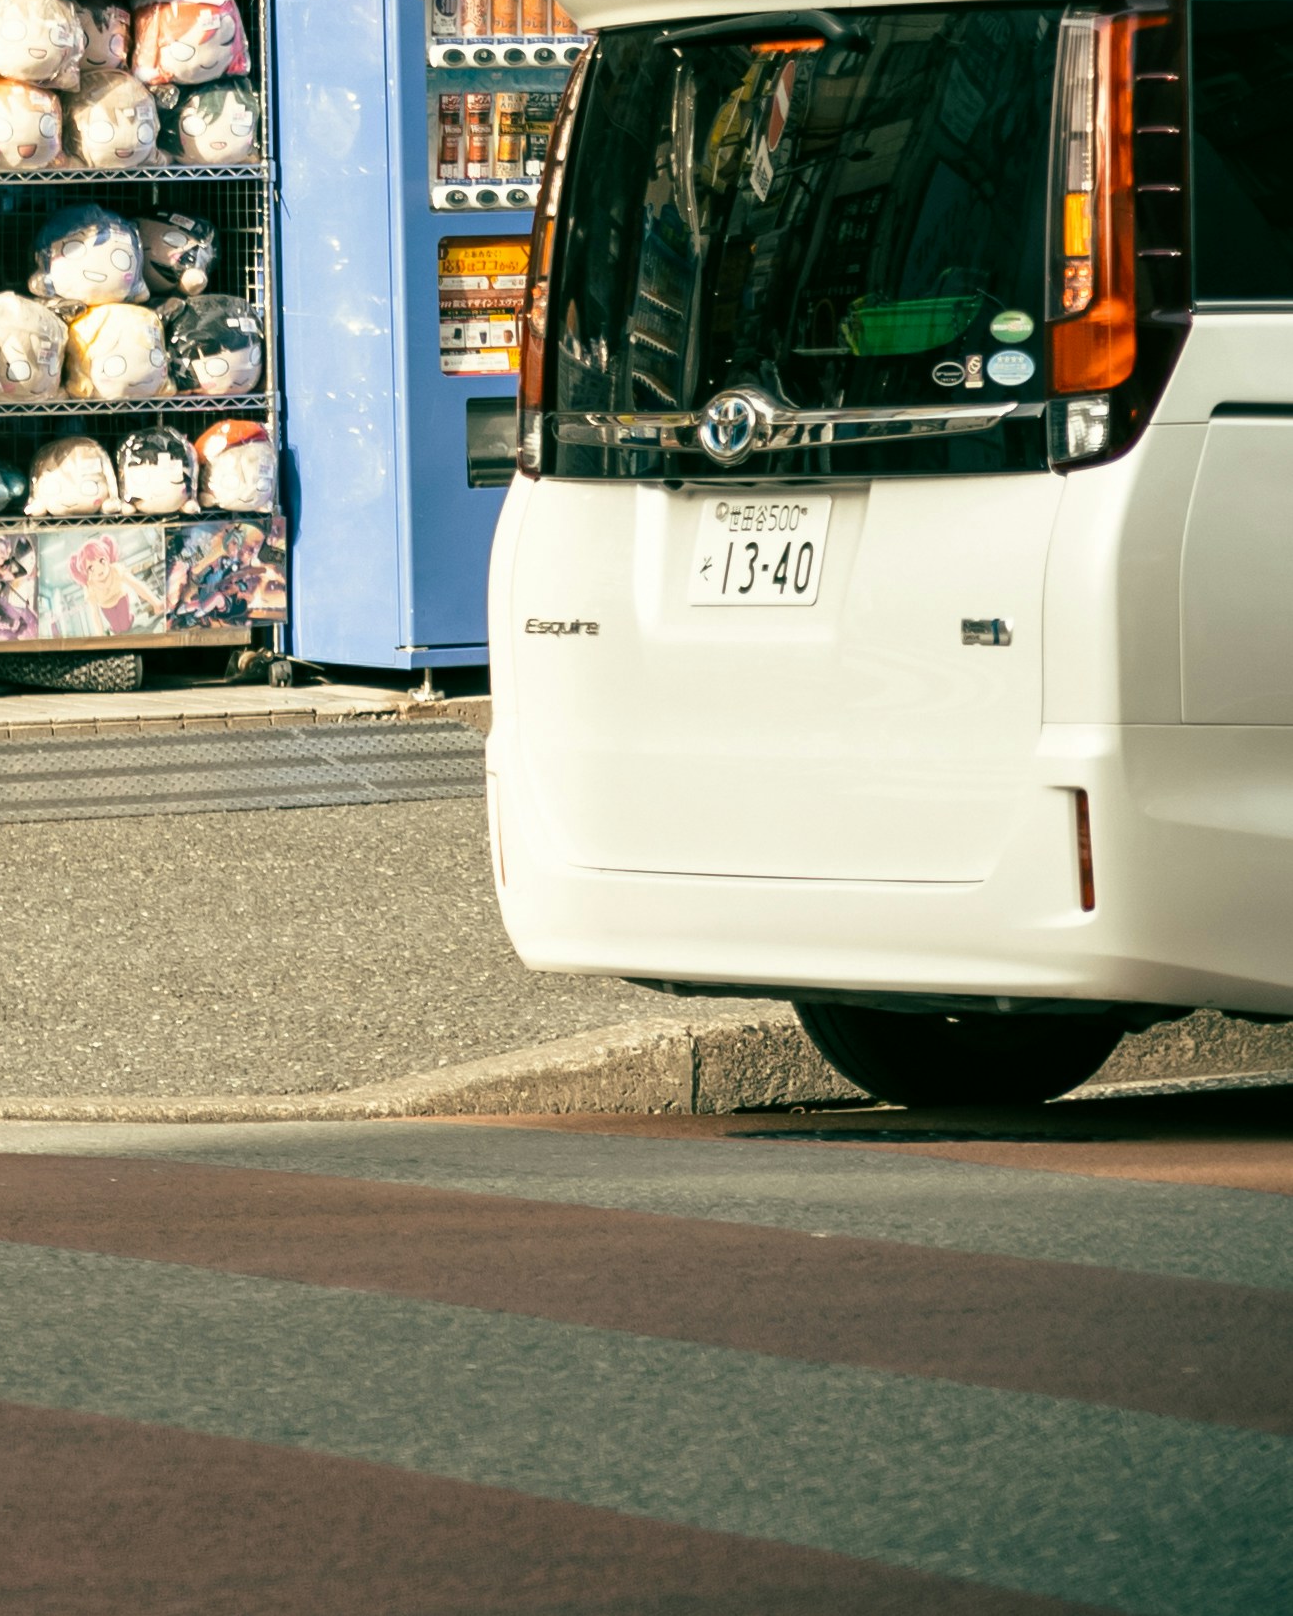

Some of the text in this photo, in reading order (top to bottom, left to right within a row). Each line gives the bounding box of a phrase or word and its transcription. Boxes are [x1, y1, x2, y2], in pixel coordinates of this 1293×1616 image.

[728, 504, 800, 533] 世田谷 500
[721, 541, 814, 595] 13-40
[524, 618, 600, 638] Esquire
